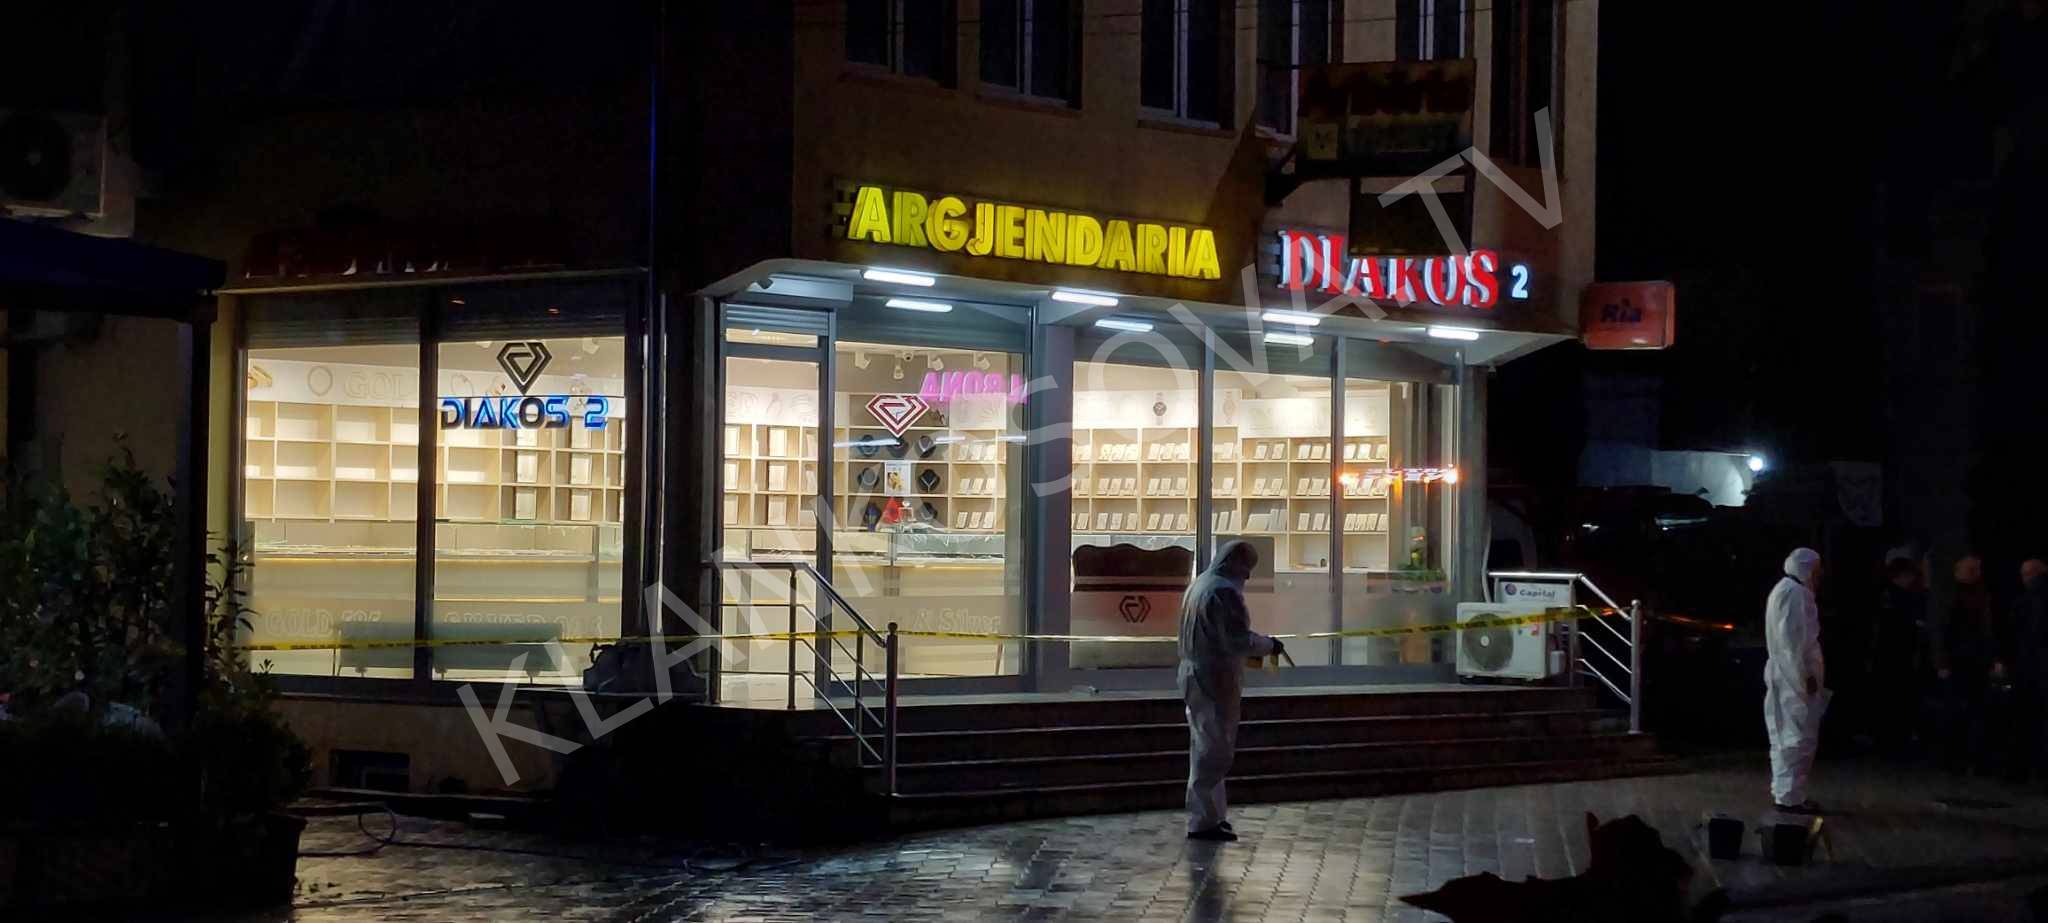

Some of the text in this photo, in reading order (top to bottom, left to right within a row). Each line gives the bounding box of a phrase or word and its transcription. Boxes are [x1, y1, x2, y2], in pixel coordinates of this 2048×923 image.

[847, 185, 1222, 280] ARGJENDARIA
[1277, 227, 1529, 310] DIAKOS 2
[440, 395, 609, 430] DIAKOS 2
[1519, 588, 1556, 600] Capital
